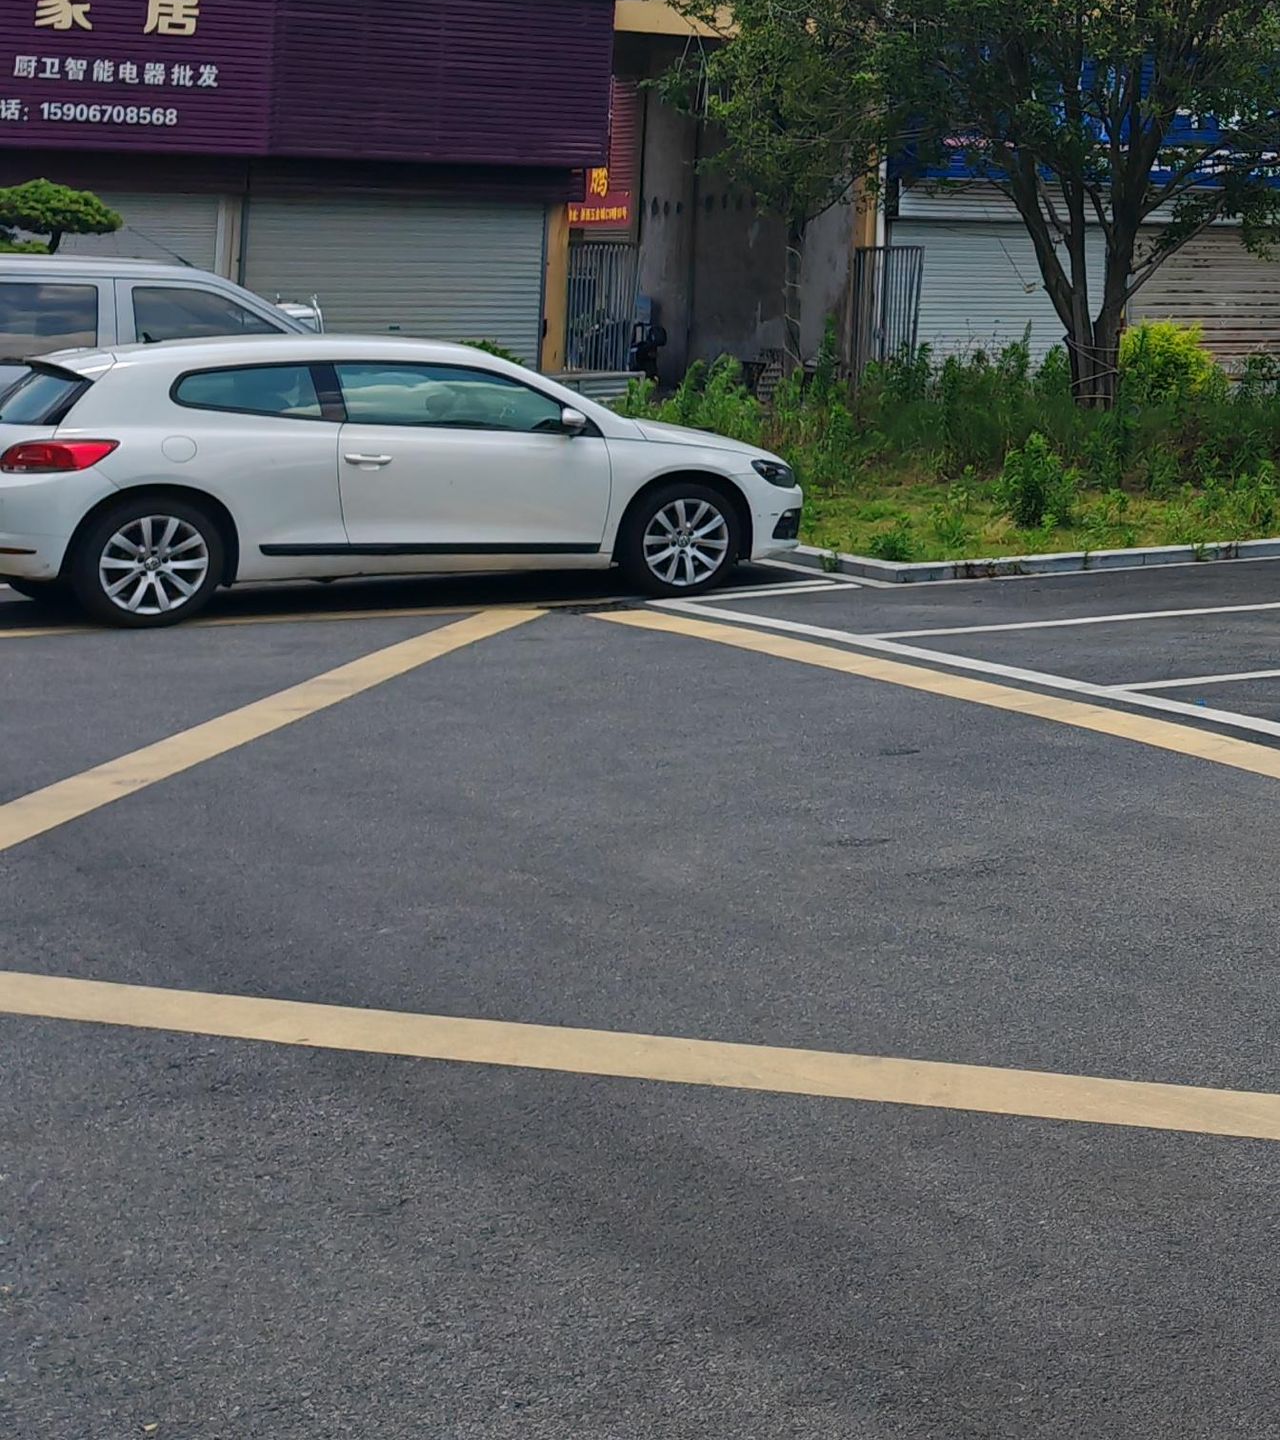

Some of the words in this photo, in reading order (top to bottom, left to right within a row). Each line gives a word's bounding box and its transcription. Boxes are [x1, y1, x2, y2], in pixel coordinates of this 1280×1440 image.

[13, 55, 219, 87] 厨卫智能电器批发
